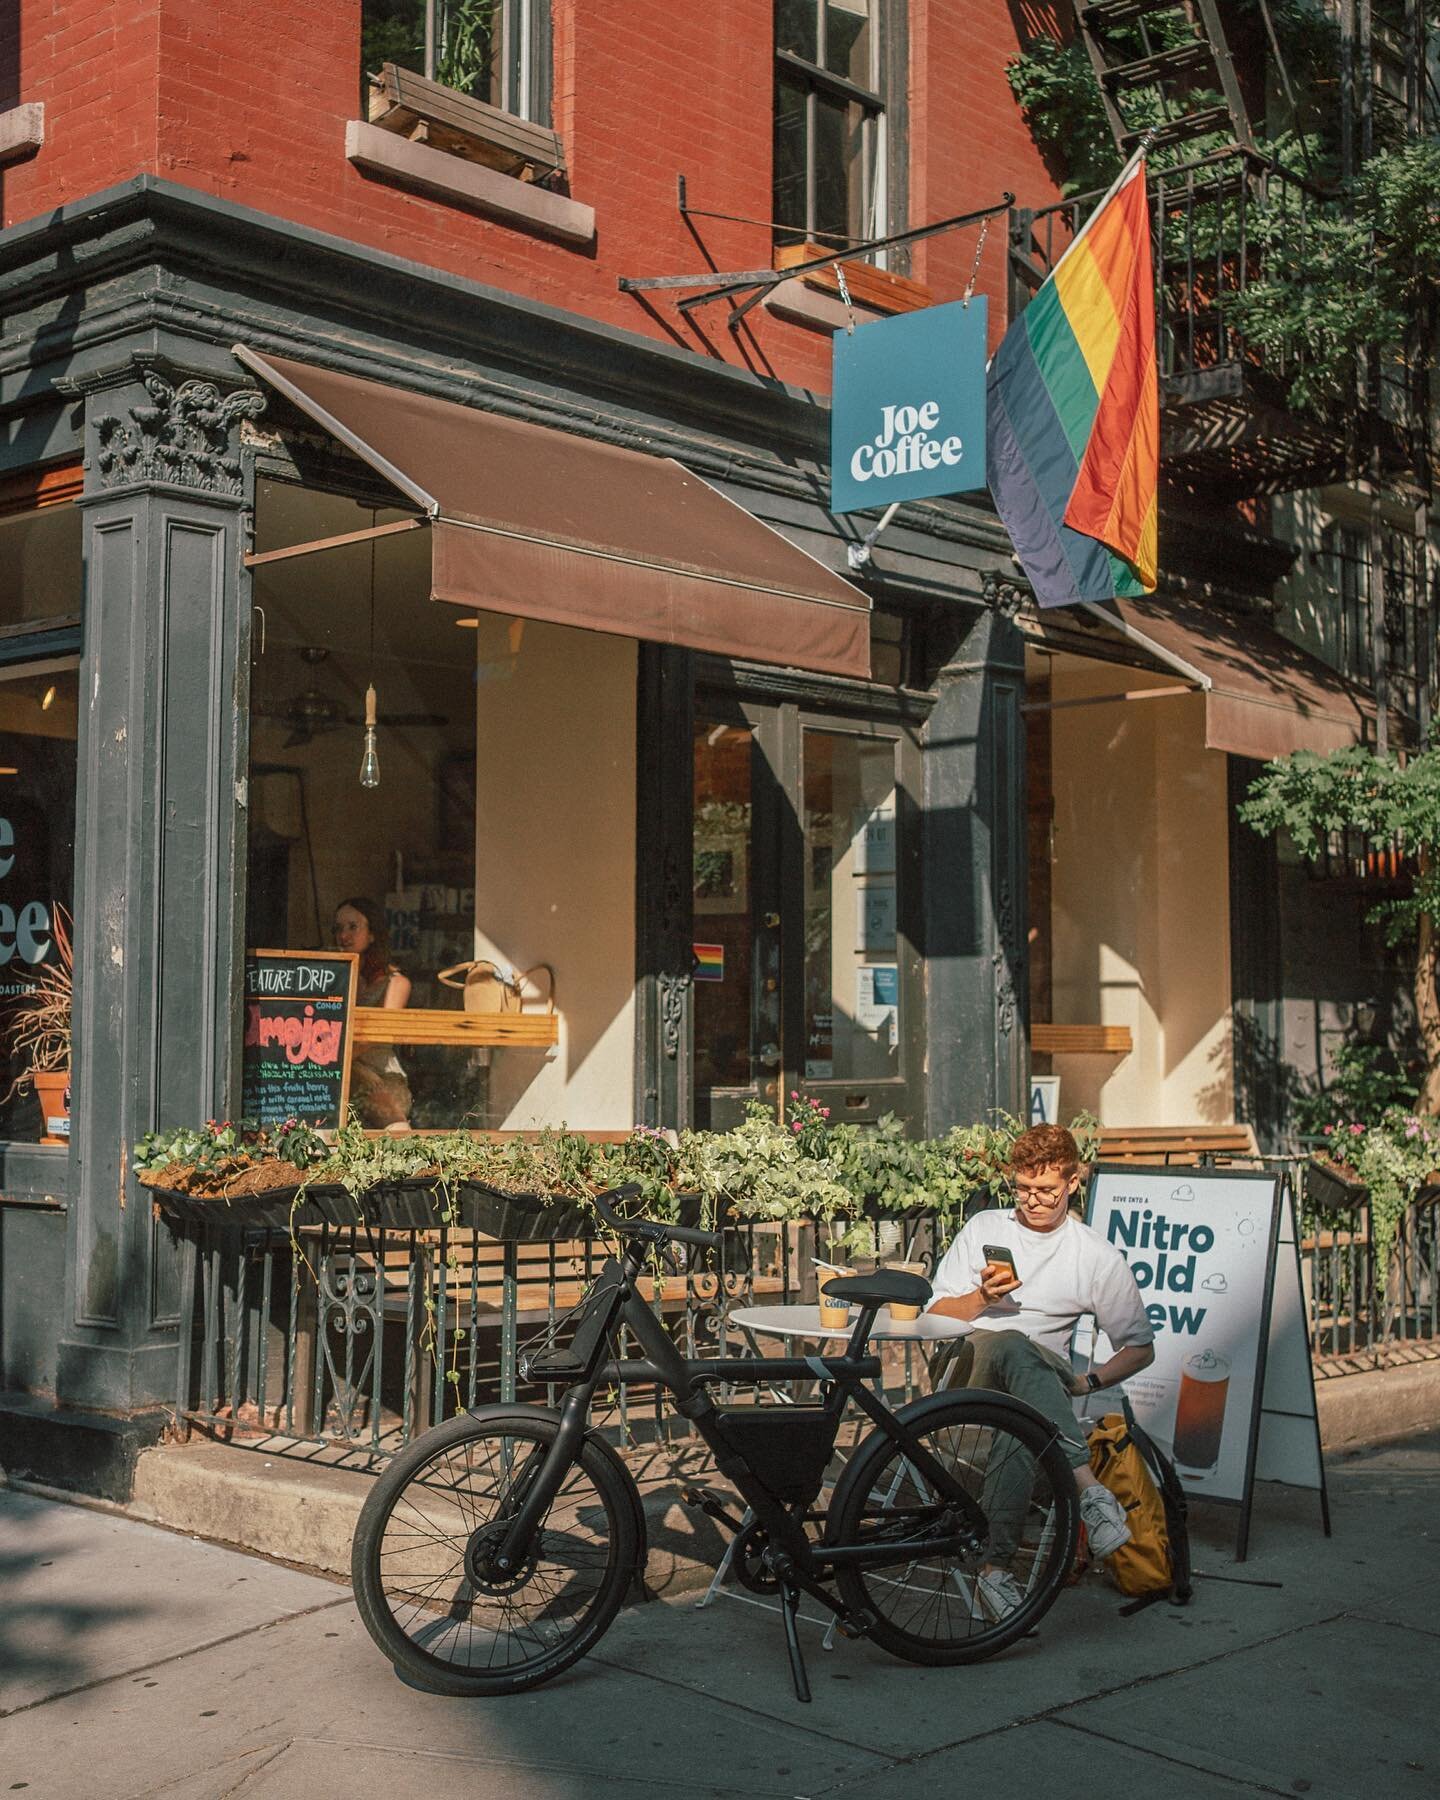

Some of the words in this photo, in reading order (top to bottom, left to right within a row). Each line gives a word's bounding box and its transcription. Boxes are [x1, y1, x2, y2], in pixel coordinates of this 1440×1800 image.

[875, 401, 940, 448] Joe
[851, 432, 963, 482] Coffee
[0, 985, 36, 996] OASTERS
[297, 966, 336, 992] DRIP
[316, 1002, 342, 1010] CONGO
[1031, 1087, 1047, 1122] A
[1107, 1209, 1214, 1253] Nitro
[1119, 1249, 1197, 1293] old
[1145, 1303, 1207, 1335] ew
